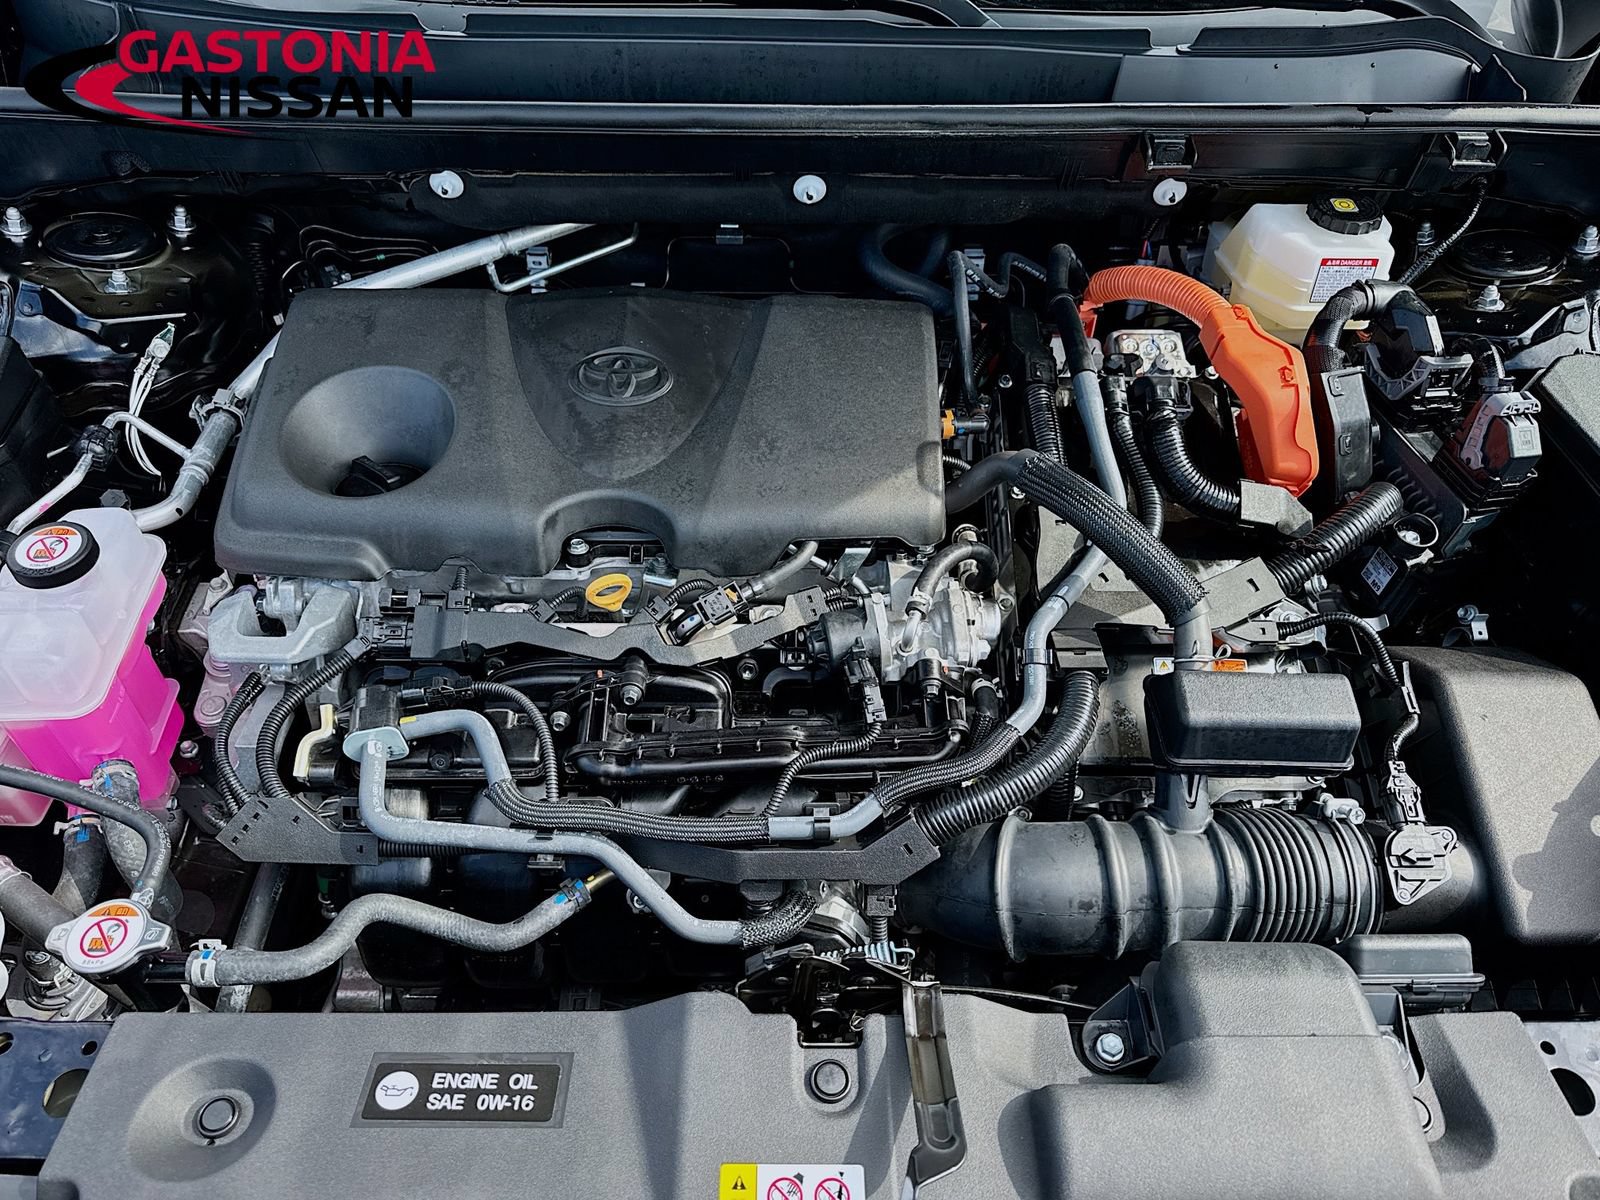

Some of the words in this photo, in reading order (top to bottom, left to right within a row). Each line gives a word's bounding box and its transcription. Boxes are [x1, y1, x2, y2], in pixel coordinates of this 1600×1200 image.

[431, 1072, 500, 1090] ENGINE
[508, 1073, 539, 1090] OIL
[425, 1092, 467, 1111] SAE
[476, 1094, 535, 1112] 0W-16
